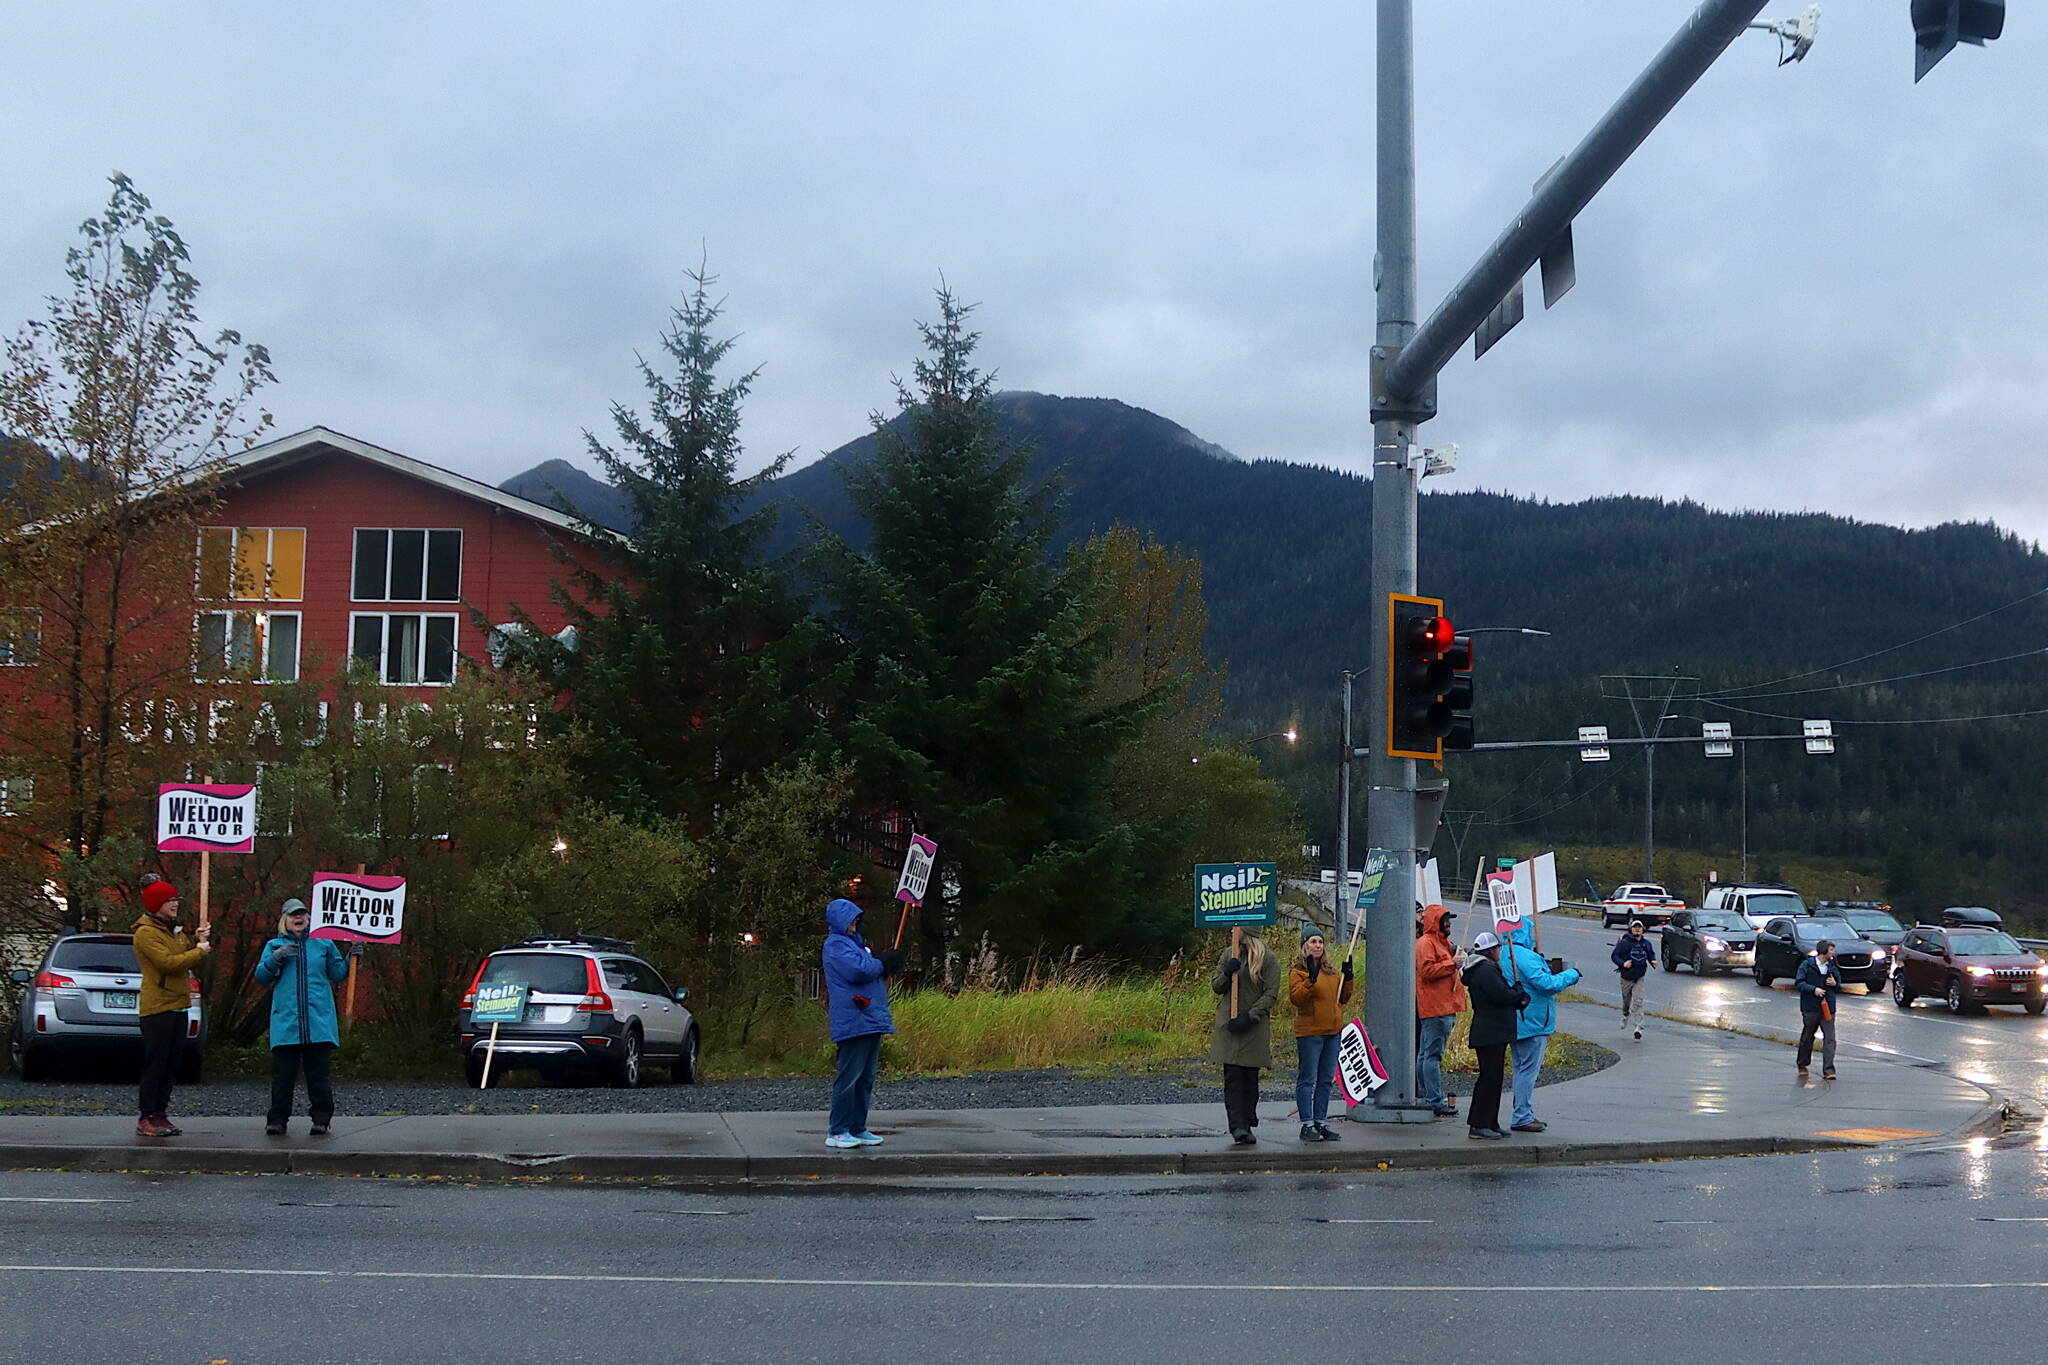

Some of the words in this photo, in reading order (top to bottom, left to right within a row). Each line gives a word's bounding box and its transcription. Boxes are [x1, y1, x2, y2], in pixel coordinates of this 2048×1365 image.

[168, 797, 243, 823] WELDON
[168, 823, 243, 836] MAYOR
[341, 888, 362, 896] BETH
[1201, 867, 1255, 892] Neil
[322, 886, 395, 915] WELDON
[1200, 885, 1269, 912] Steininger
[322, 912, 395, 929] MAYOR
[478, 984, 517, 1001] Neil
[1339, 1046, 1362, 1095] AYOR
[1341, 1029, 1373, 1089] WELDON
